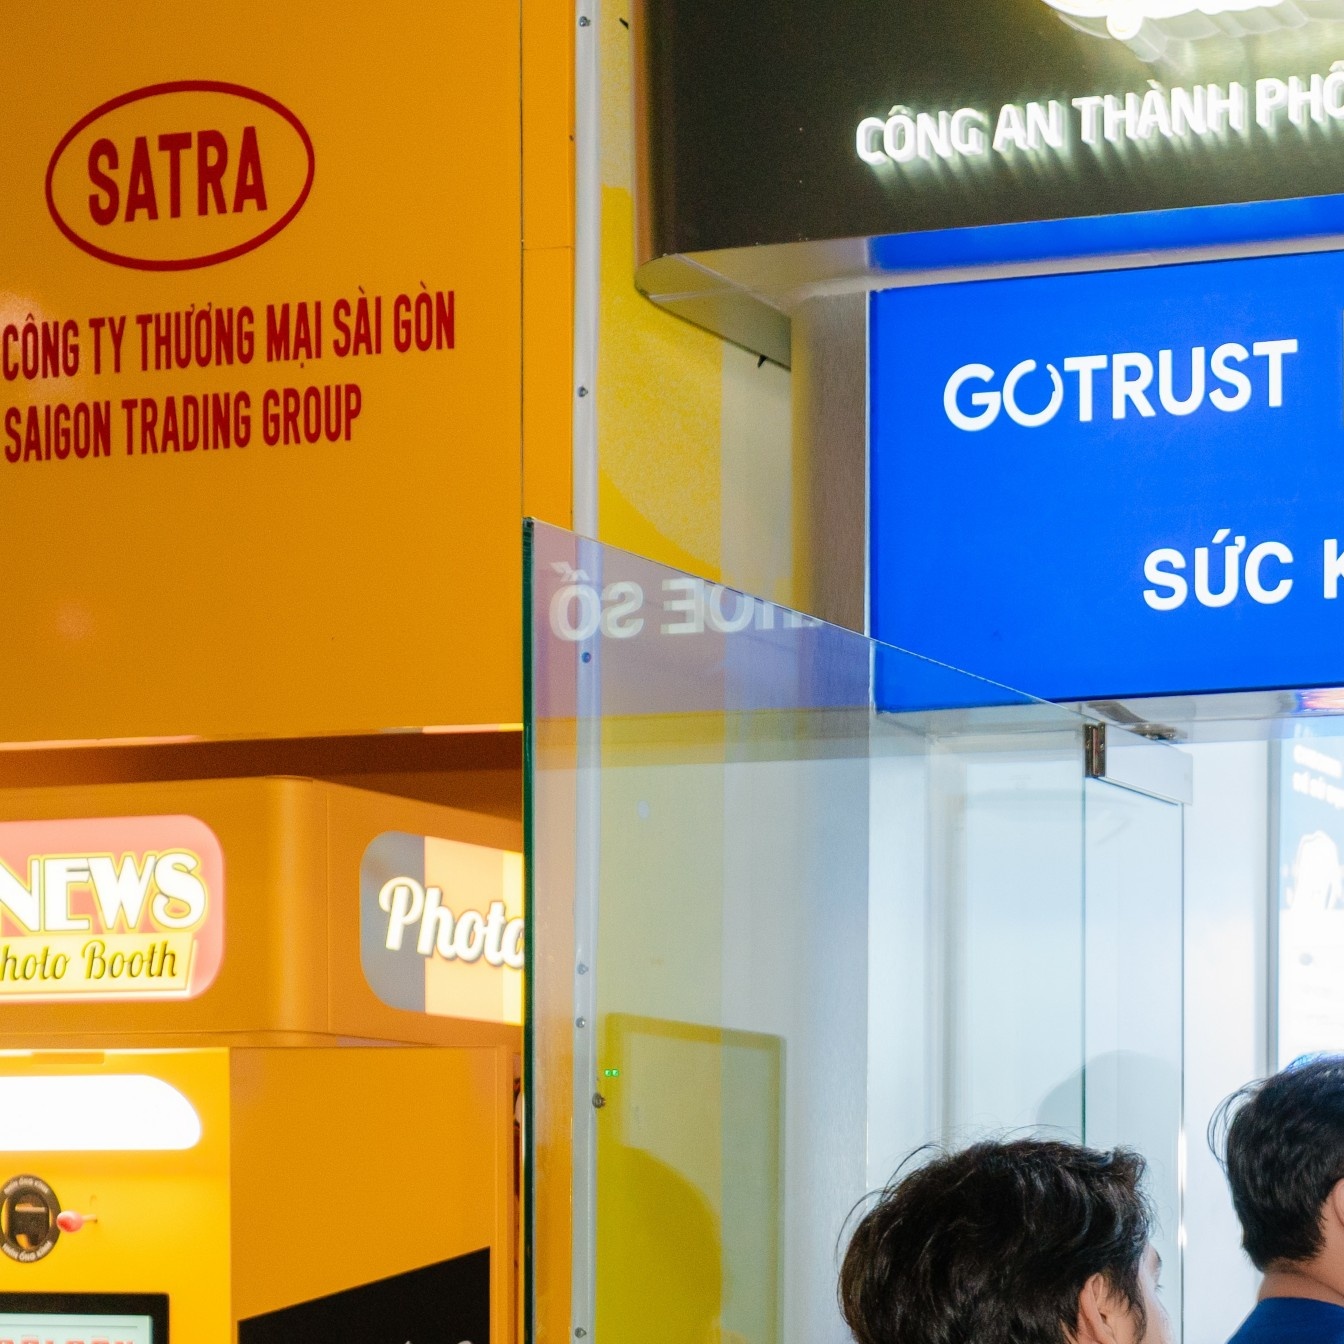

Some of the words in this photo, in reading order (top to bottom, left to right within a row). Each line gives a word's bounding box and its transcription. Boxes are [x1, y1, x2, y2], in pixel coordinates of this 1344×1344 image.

[855, 106, 987, 165] CÔNG
[993, 100, 1064, 152] AN
[1072, 79, 1244, 143] THÀNH
[87, 125, 268, 226] SATRA
[2, 311, 80, 381] CÔNG
[89, 316, 126, 375] TY
[136, 303, 256, 370] THƯƠNG
[267, 301, 322, 368] MẠI
[332, 286, 383, 358] SÀI
[393, 281, 456, 351] GÒN
[4, 399, 112, 464] SAIGON
[121, 389, 252, 456] TRADING
[262, 383, 363, 444] GROUP
[944, 339, 1298, 431] GOTRUST
[1142, 530, 1294, 611] SỨC
[0, 852, 206, 932] NEWS
[379, 876, 524, 968] Photo
[0, 945, 70, 981] hoto
[81, 939, 177, 980] Booth
